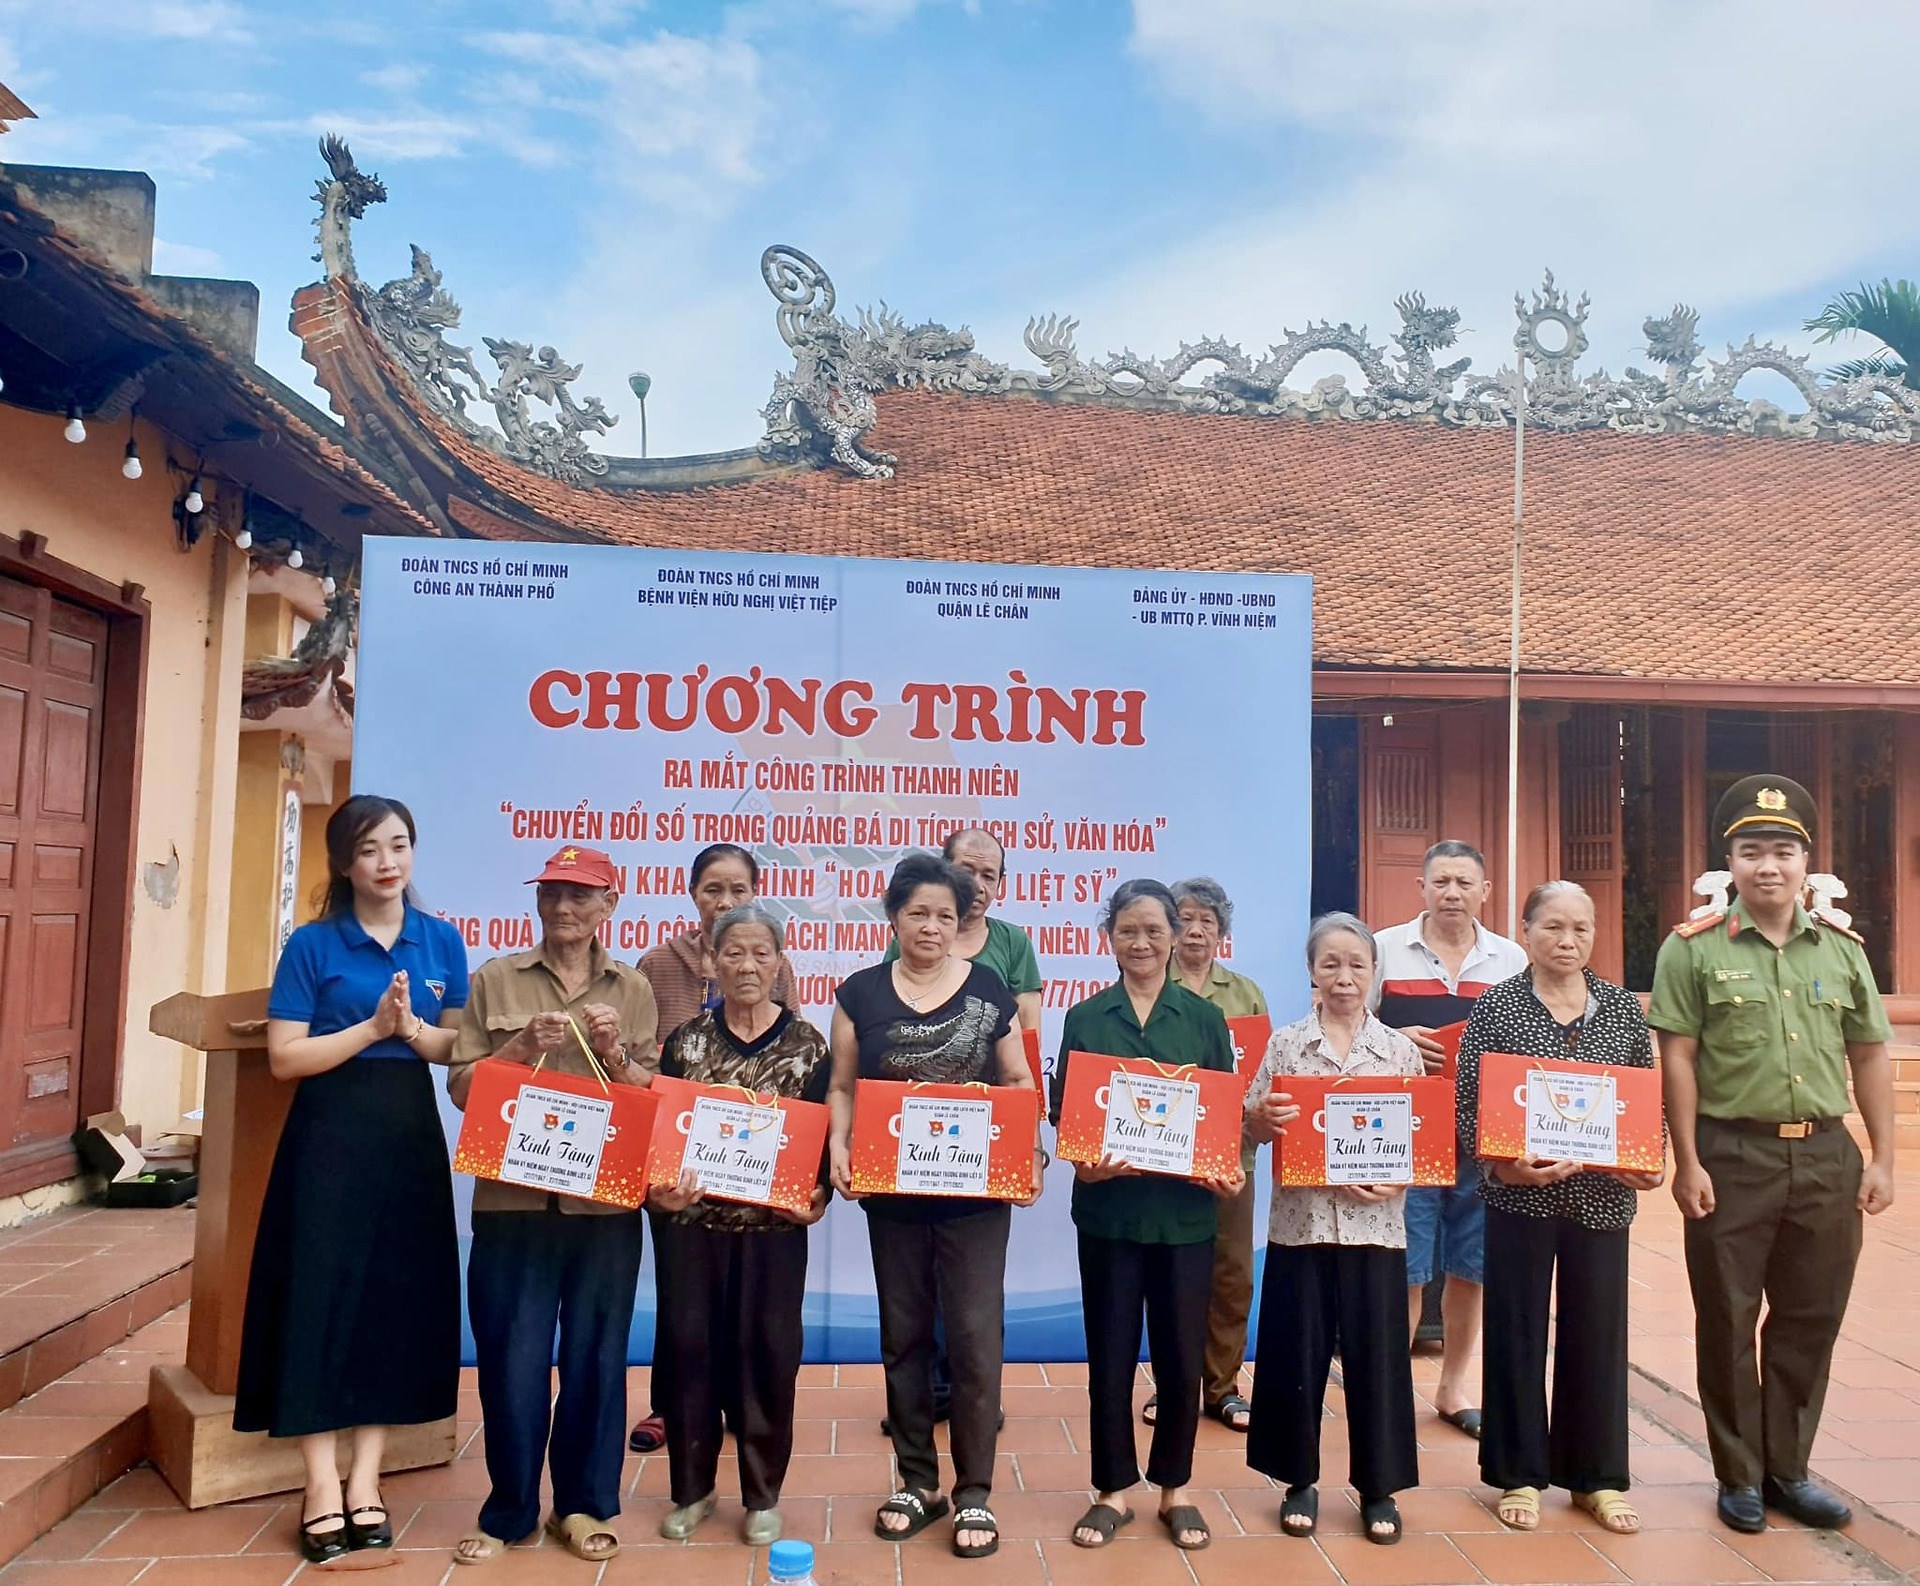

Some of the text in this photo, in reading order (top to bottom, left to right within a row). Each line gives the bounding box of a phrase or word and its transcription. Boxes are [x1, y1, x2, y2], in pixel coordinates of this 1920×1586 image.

[402, 557, 569, 579] ĐOÀN TNCS HỒ CHÍ MINH
[658, 567, 820, 589] ĐOÀN TNCS HỒ CHÍ MINH
[414, 578, 555, 599] CÔNG AN THÀNH PHỐ
[906, 579, 1060, 600] ĐOÀN TNCS HỒ CHÍ MINH
[1133, 587, 1167, 605] ĐẢNG
[1170, 587, 1188, 606] ỦY
[1199, 592, 1233, 606] HĐND
[638, 586, 838, 613] BỆNH VIỆN HỮU NGHỊ VIỆT TIỆP
[937, 599, 1029, 620] QUẬN LÊ CHÂN
[1141, 611, 1157, 624] UB
[1161, 612, 1194, 627] MTTQ
[1198, 612, 1208, 626] P.
[1211, 610, 1241, 627] VĨNH
[1244, 610, 1276, 631] NIỆM
[530, 663, 1147, 747] CHƯƠNG TRÌNH
[665, 750, 1019, 797] RA MẮT CÔNG TRÌNH THANH NIÊN
[501, 800, 603, 839] “CHUYỂN
[610, 800, 648, 840] ĐỔI
[656, 803, 687, 841] SỐ
[693, 814, 765, 842] TRONG
[773, 806, 846, 846] QUẢNG
[854, 811, 882, 845] BÁ
[890, 818, 909, 845] DI
[1024, 812, 1057, 852] SỬ,
[1065, 817, 1106, 850] VĂN
[1113, 818, 1166, 852] HÓA”
[636, 866, 691, 895] KHA
[1017, 868, 1065, 907] LIỆT
[1075, 869, 1116, 902] SỸ”
[488, 911, 534, 951] QUÀ
[619, 914, 649, 949] CÓ
[784, 916, 827, 951] ÁCH
[1039, 920, 1090, 955] NIÊN
[1111, 1117, 1146, 1138] Kính
[1532, 1113, 1567, 1132] Kính
[514, 1133, 550, 1156] Kính
[690, 1143, 727, 1164] Kính
[904, 1144, 940, 1162] Kính
[1331, 1138, 1365, 1155] Kính
